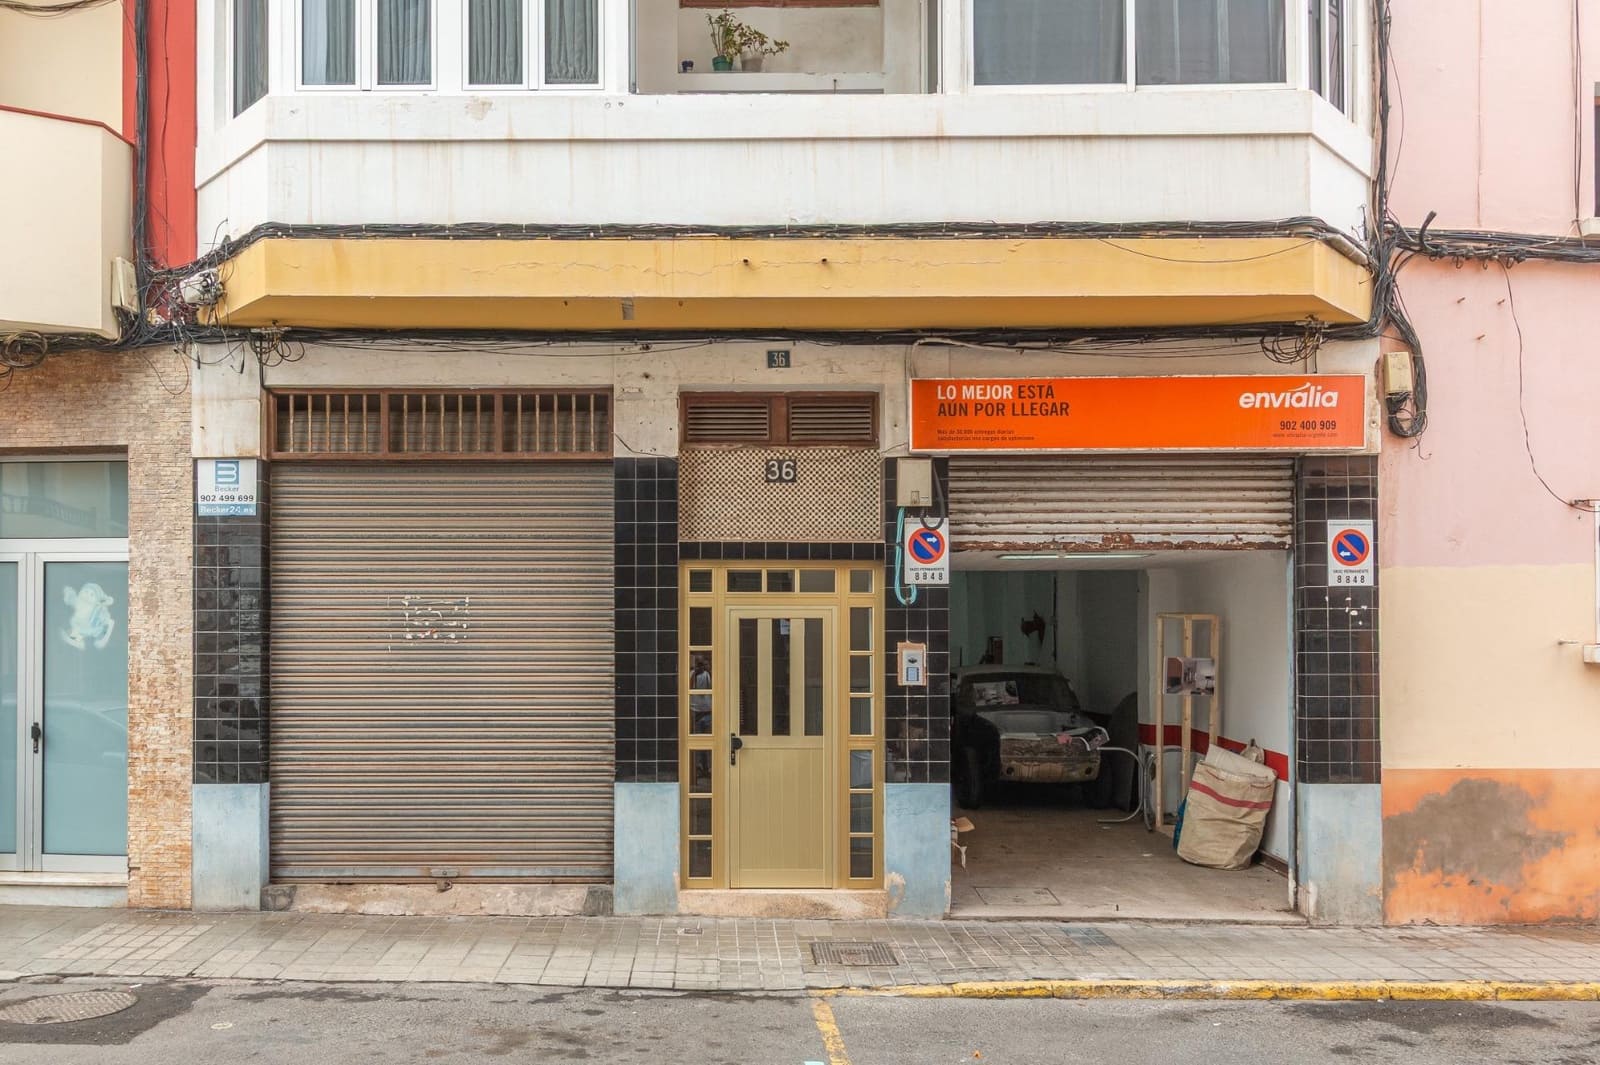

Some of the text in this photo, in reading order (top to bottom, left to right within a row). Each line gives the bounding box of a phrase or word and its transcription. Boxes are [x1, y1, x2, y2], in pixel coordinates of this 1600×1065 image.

[771, 352, 785, 366] 36
[937, 382, 1055, 400] LO MEJOR ESTÁ
[937, 399, 1070, 417] AÚN POR LLEGAR
[1279, 420, 1337, 431] 902 400 909
[767, 461, 794, 480] 36
[200, 494, 254, 502] 902 499 699
